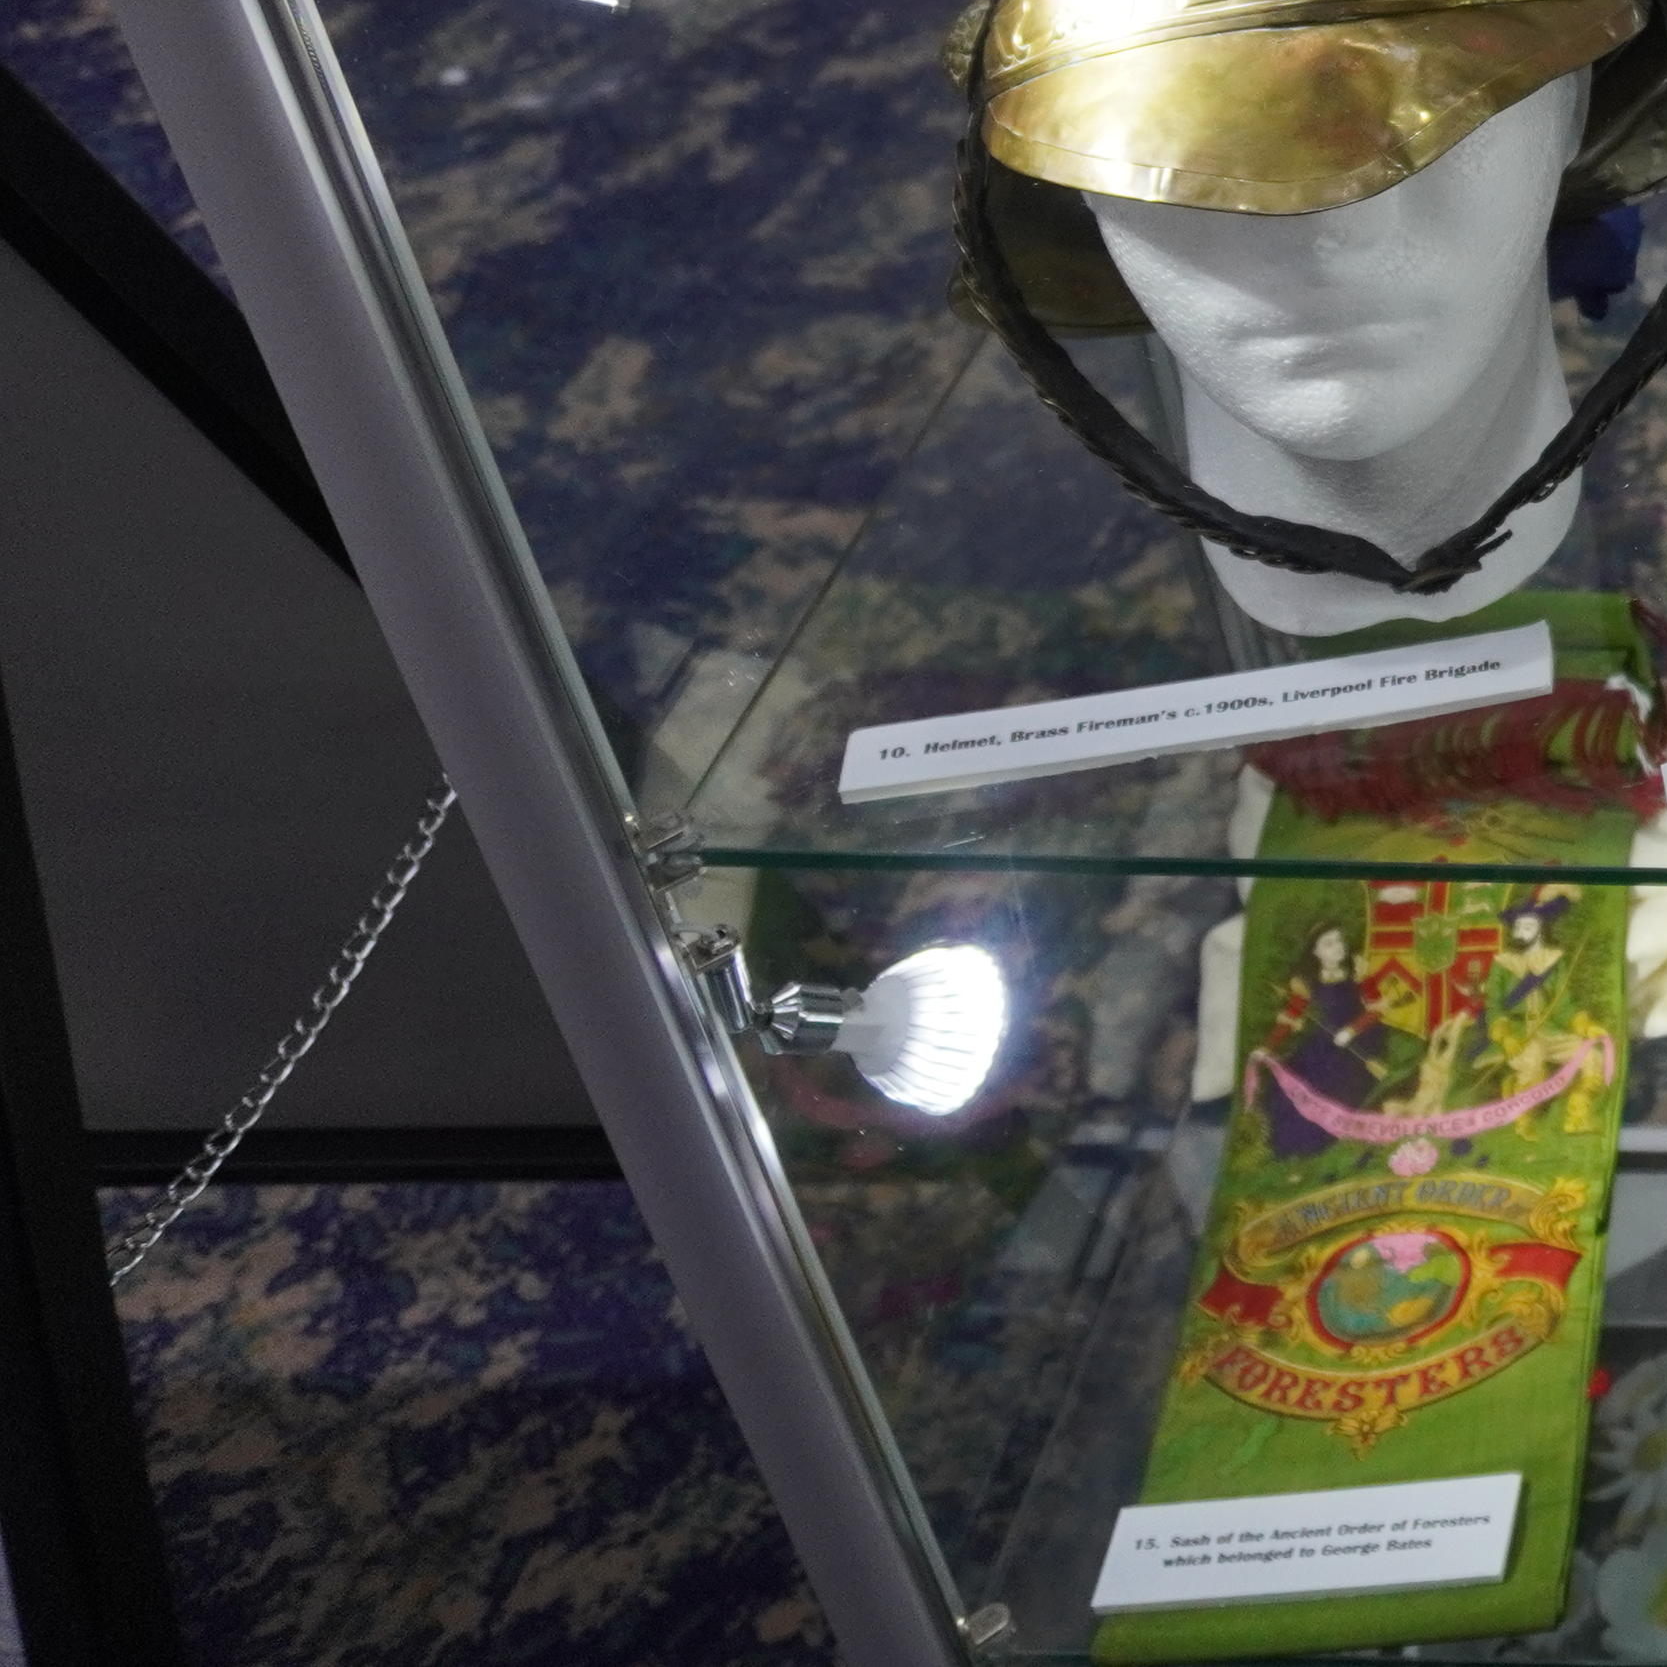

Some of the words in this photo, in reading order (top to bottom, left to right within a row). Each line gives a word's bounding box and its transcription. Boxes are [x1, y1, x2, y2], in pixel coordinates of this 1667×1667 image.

[879, 746, 911, 760] 10.
[923, 734, 1002, 755] Helmet,
[1009, 726, 1070, 743] Brass
[1076, 709, 1177, 734] Fireman's
[1183, 696, 1274, 718] c.1900s,
[1282, 678, 1373, 703] Liverpool
[1379, 674, 1418, 688] Fire
[1424, 660, 1501, 681] Brigade
[1214, 1324, 1525, 1413] FORESTERS
